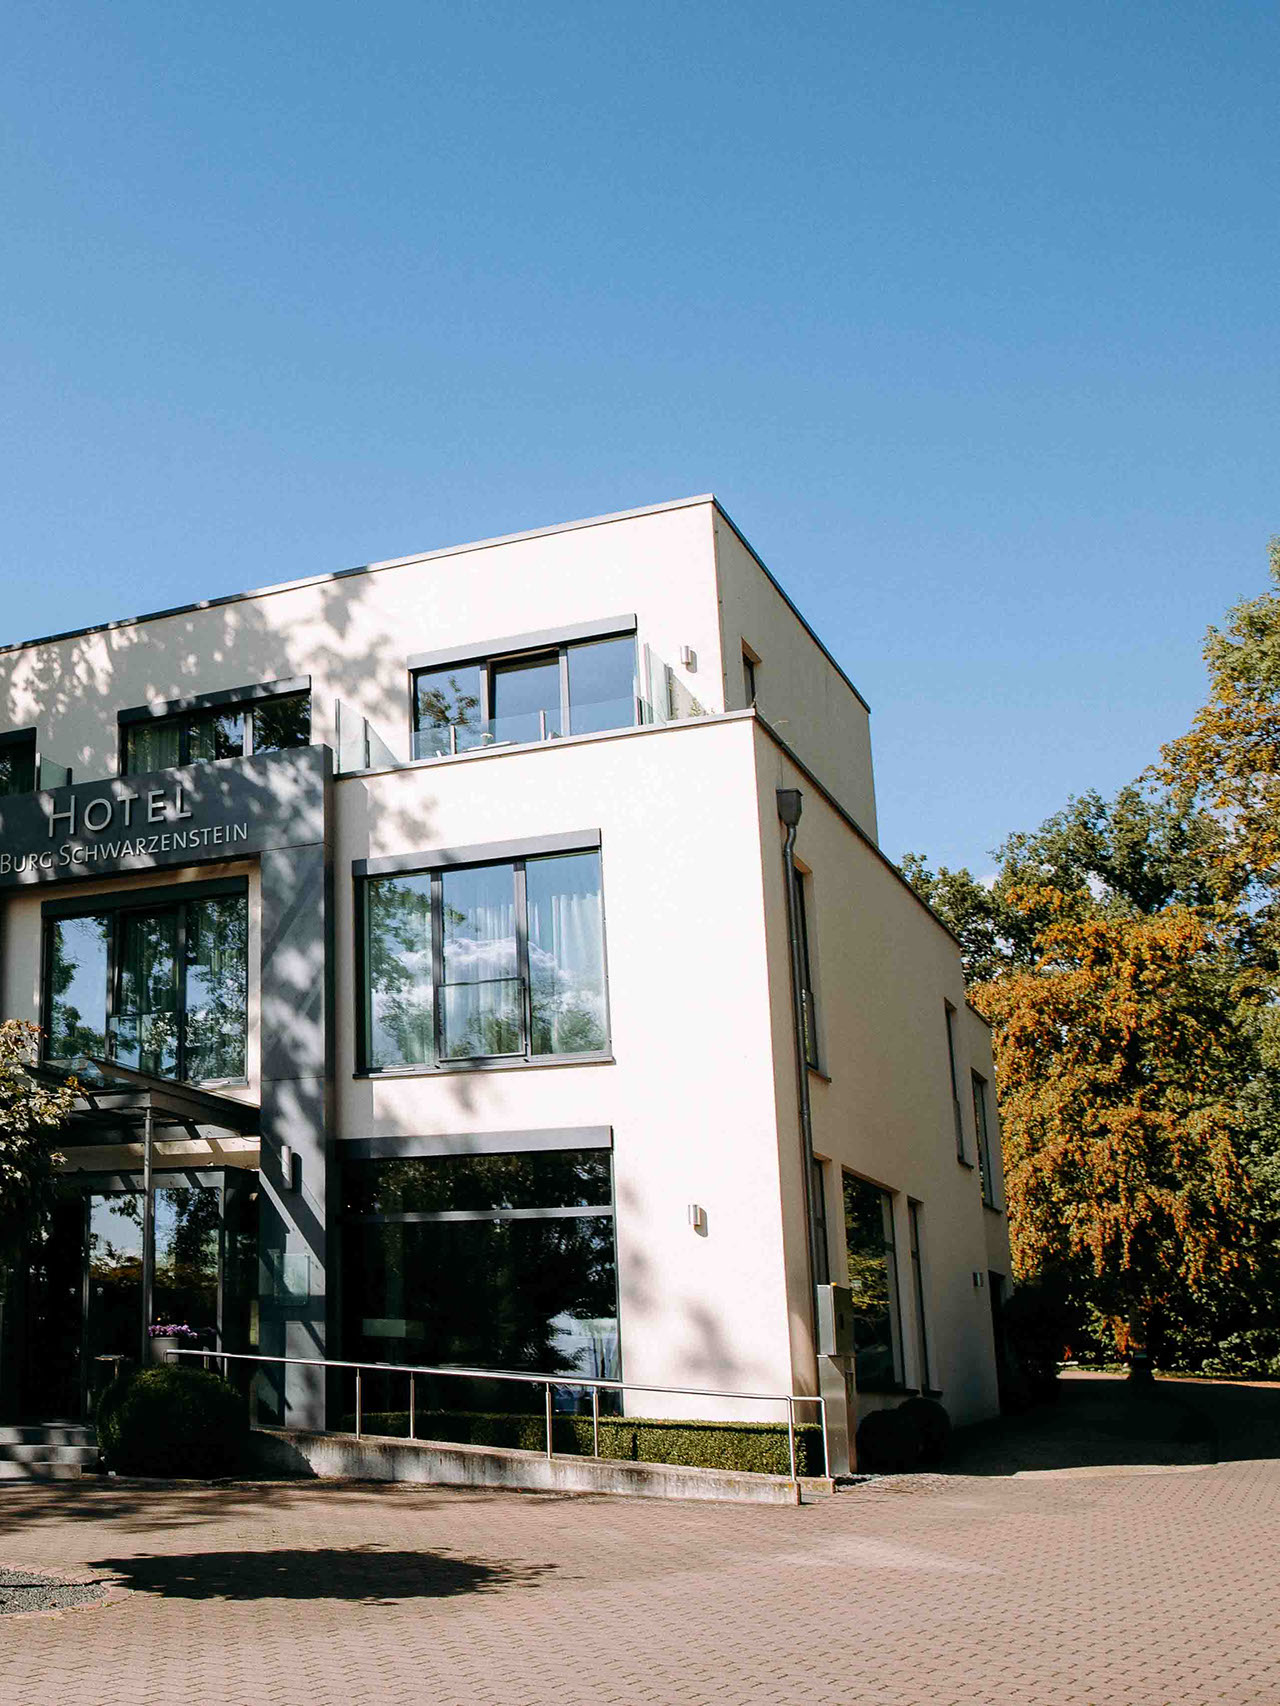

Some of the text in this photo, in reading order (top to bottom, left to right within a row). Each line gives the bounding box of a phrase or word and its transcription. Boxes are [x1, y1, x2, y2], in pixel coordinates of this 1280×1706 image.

[48, 786, 192, 838] HOTEL
[0, 823, 248, 874] BURG SCHWARZENSTEIN
